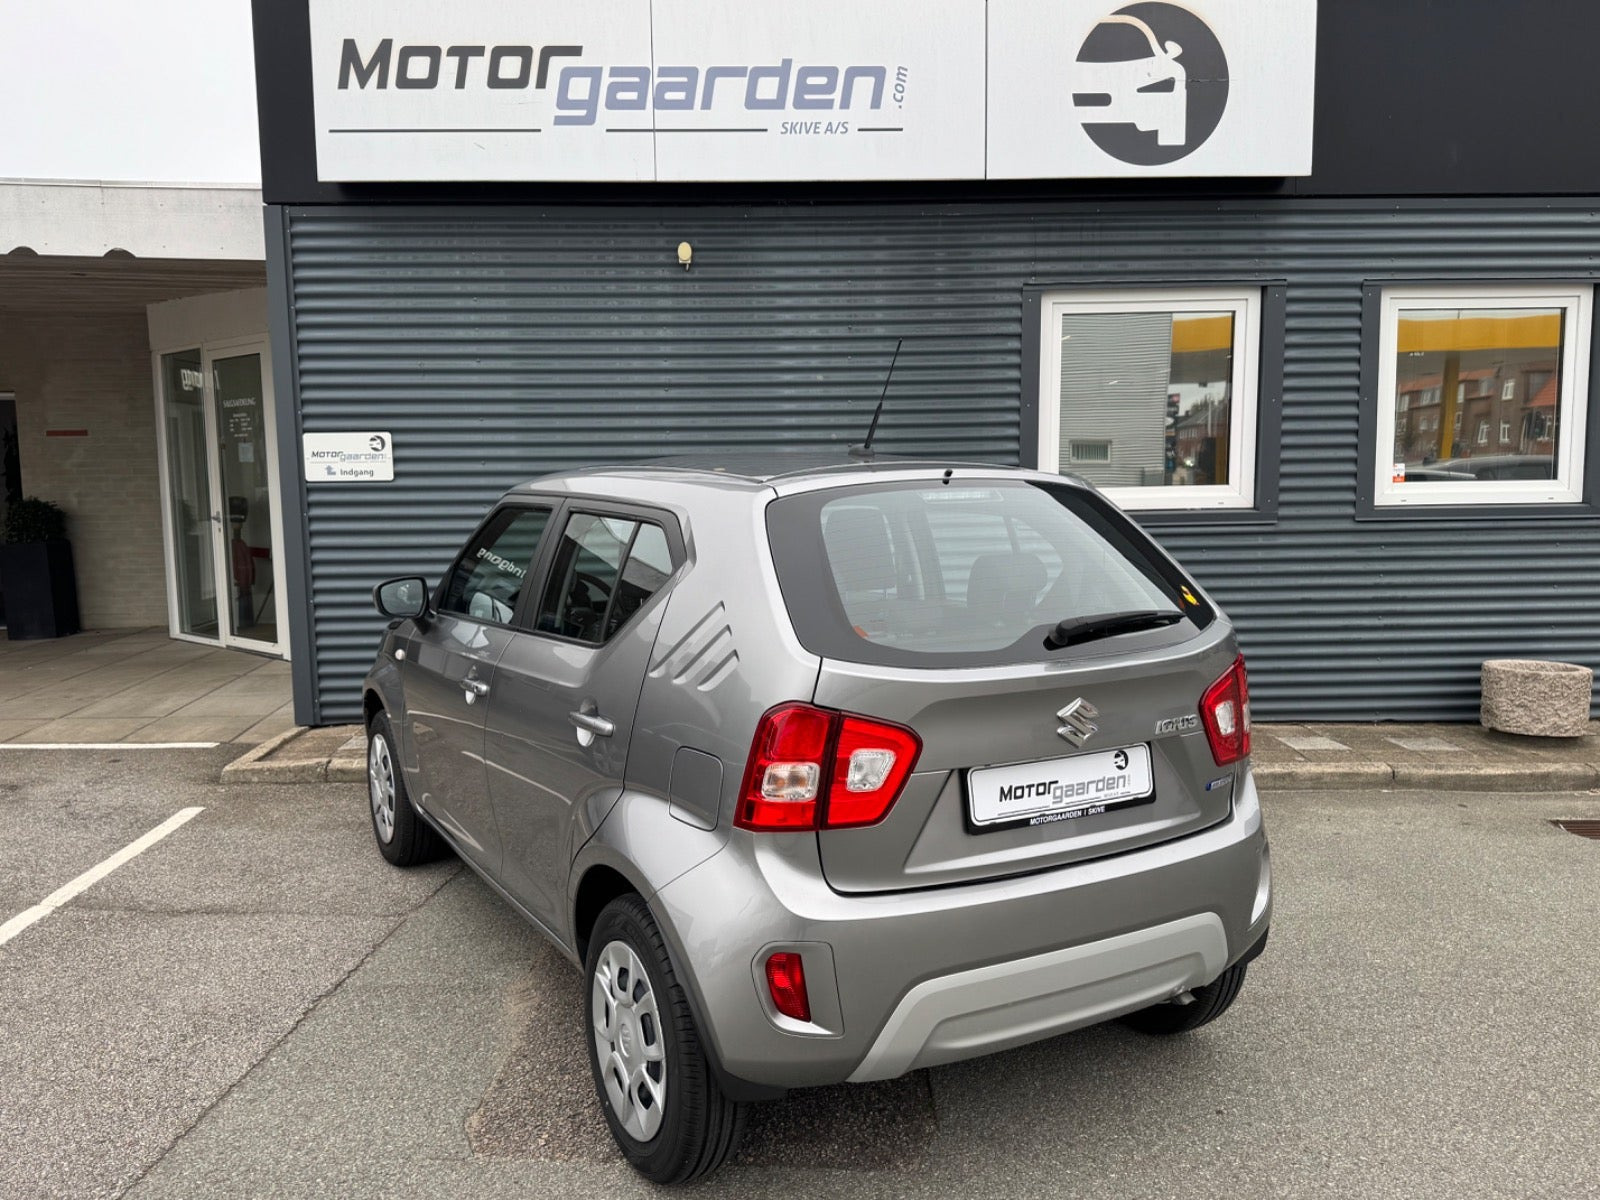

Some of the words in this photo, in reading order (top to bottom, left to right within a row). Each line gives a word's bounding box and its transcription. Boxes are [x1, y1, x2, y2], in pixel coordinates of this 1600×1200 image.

[893, 65, 909, 109] .com
[780, 121, 822, 135] SKIVE
[824, 121, 849, 135] A/S
[340, 468, 374, 477] Indgang
[1030, 810, 1082, 825] MOTORGAARDEN
[1088, 806, 1106, 816] SKIVE
